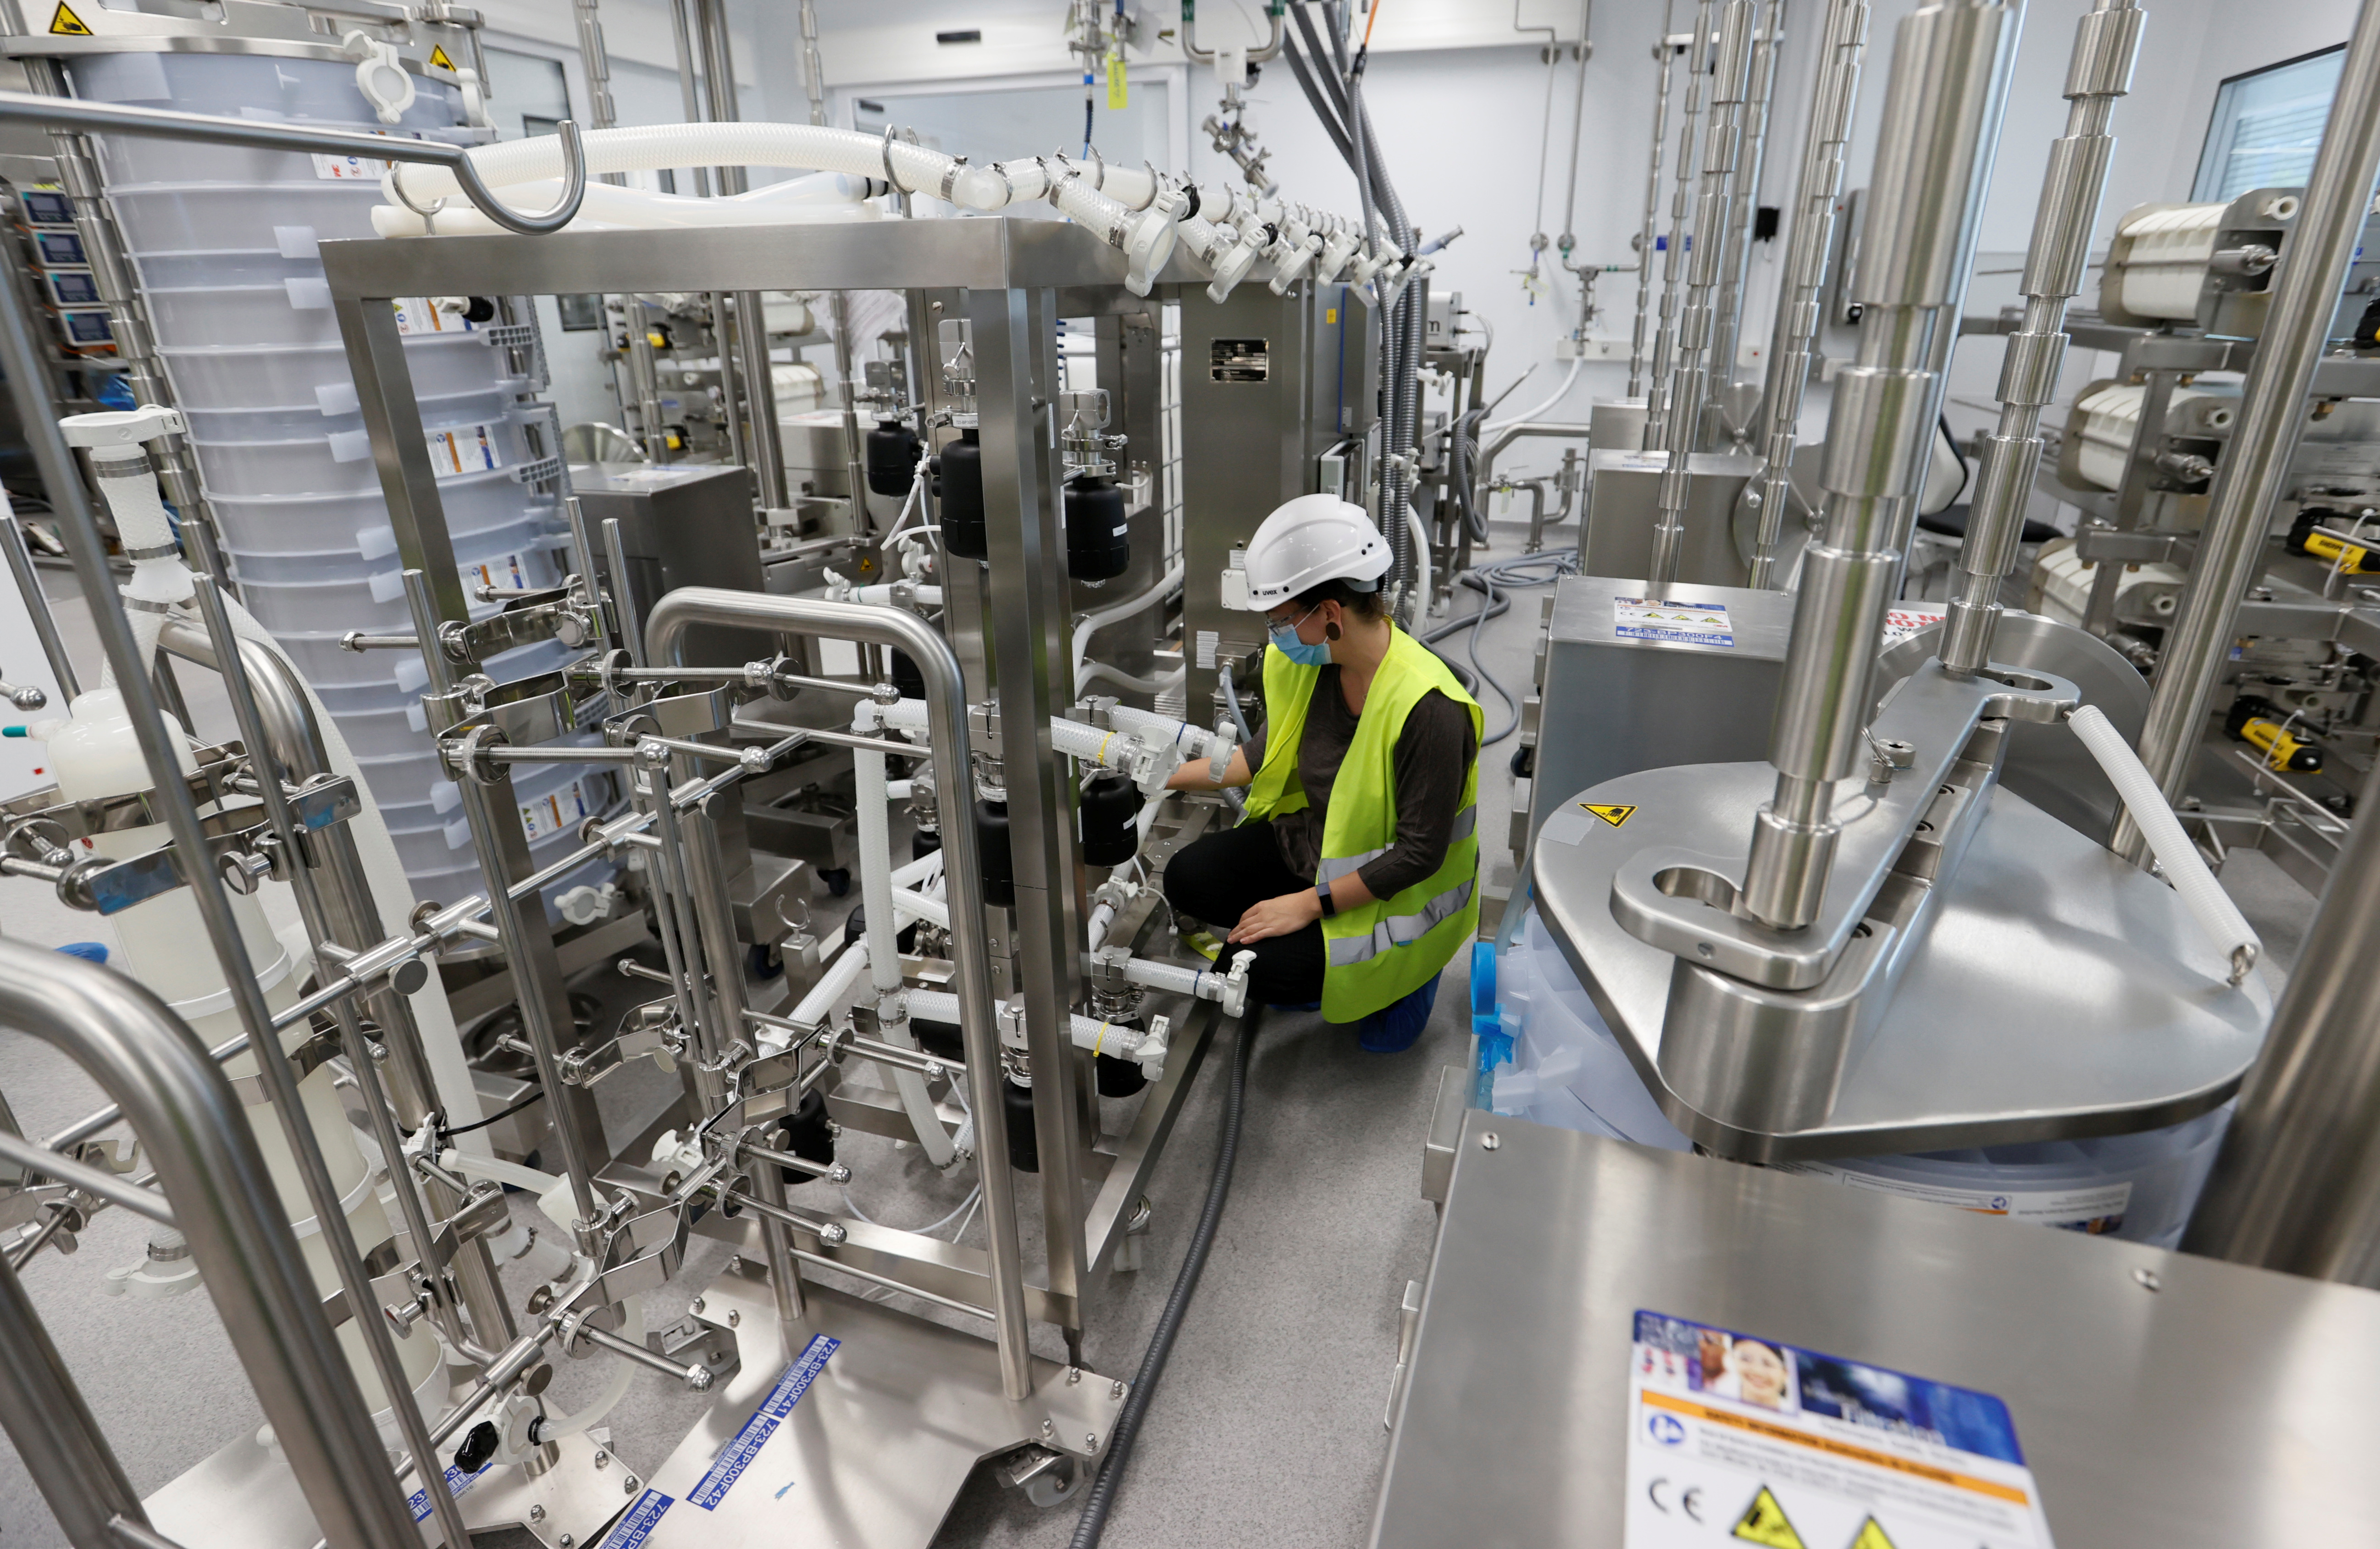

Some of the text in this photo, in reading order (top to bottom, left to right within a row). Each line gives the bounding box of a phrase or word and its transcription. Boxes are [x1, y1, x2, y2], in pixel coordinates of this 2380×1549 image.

[1626, 627, 1723, 640] 723-BP300F4
[777, 1341, 838, 1417] 723-BP300F41
[705, 1422, 777, 1506] 723-BP300F42
